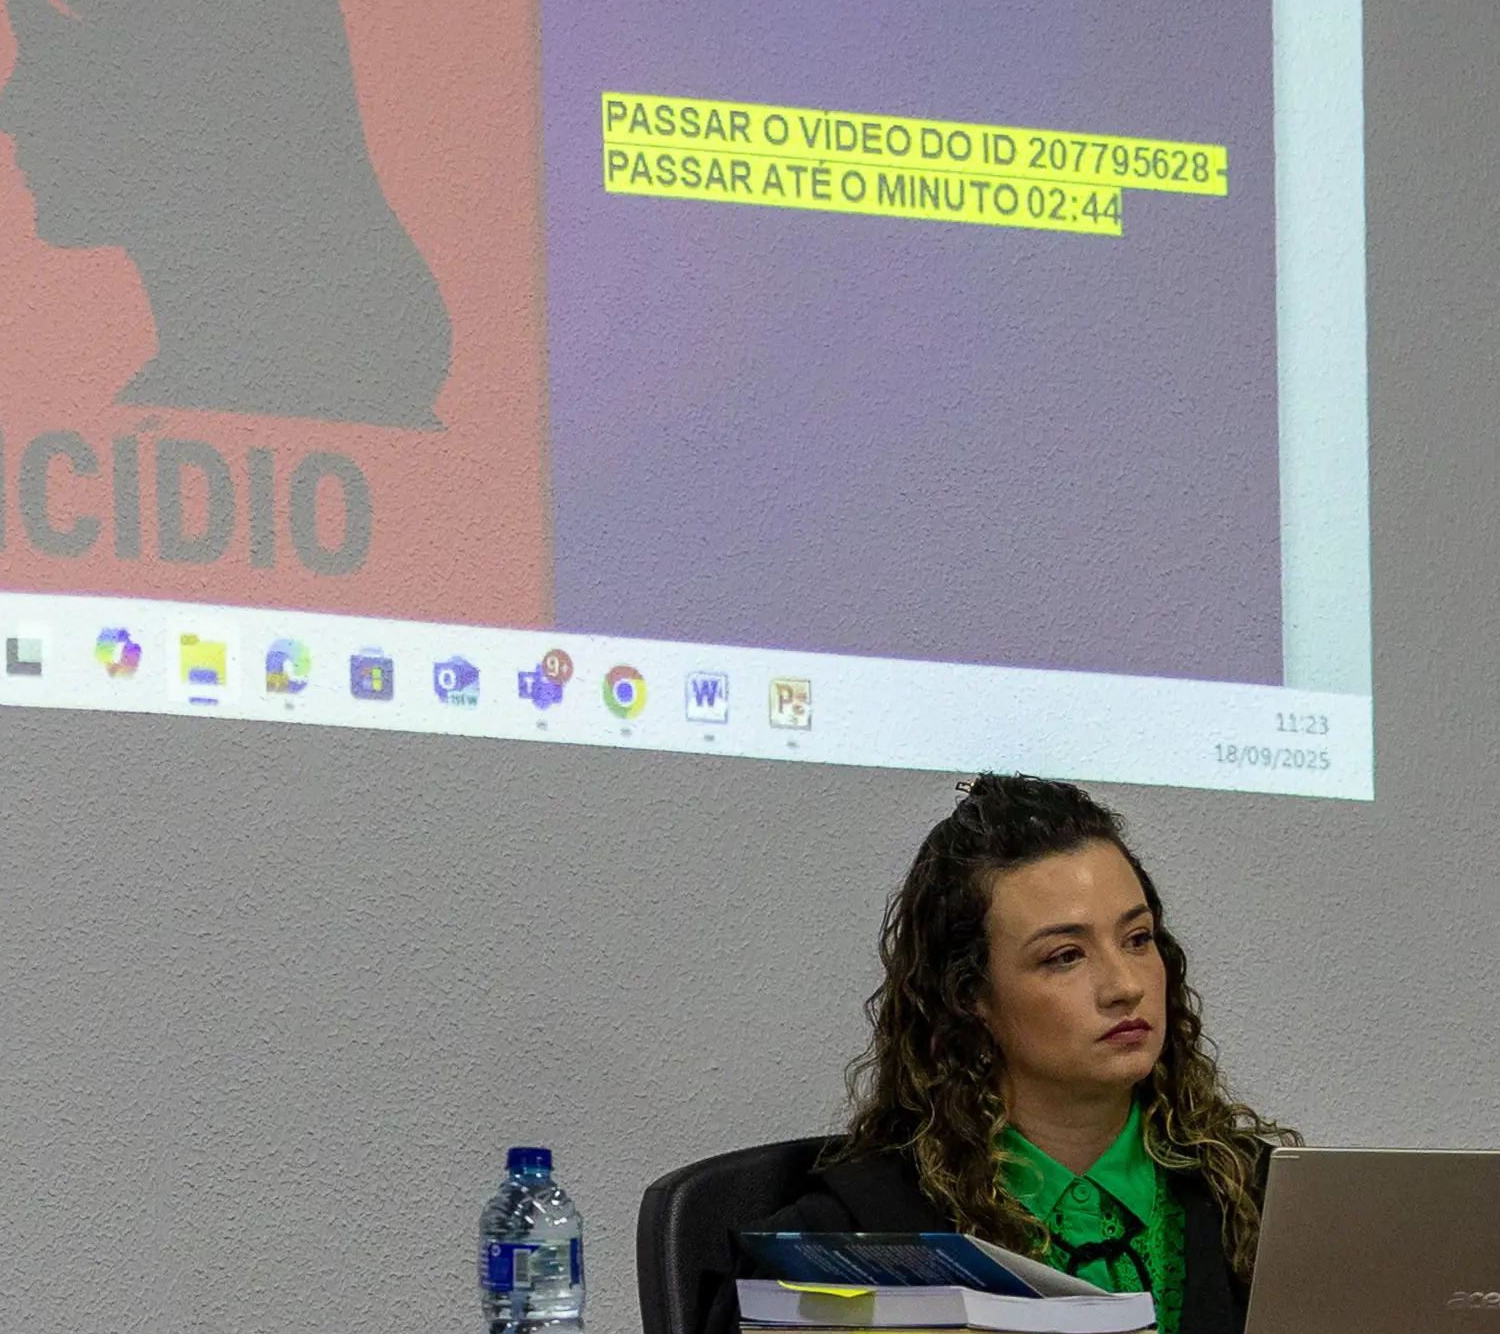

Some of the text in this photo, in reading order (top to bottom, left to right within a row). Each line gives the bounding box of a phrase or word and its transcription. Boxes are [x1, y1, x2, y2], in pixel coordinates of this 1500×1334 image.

[605, 99, 753, 145] PASSAR
[763, 114, 790, 146] O
[798, 109, 912, 158] VÍDEO
[920, 129, 972, 163] DO
[982, 134, 1017, 167] ID
[606, 149, 1122, 228] PASSAR ATÉ O MINUTO 02:44
[1275, 711, 1330, 736] 11:23
[1213, 743, 1332, 771] 18/09/2025
